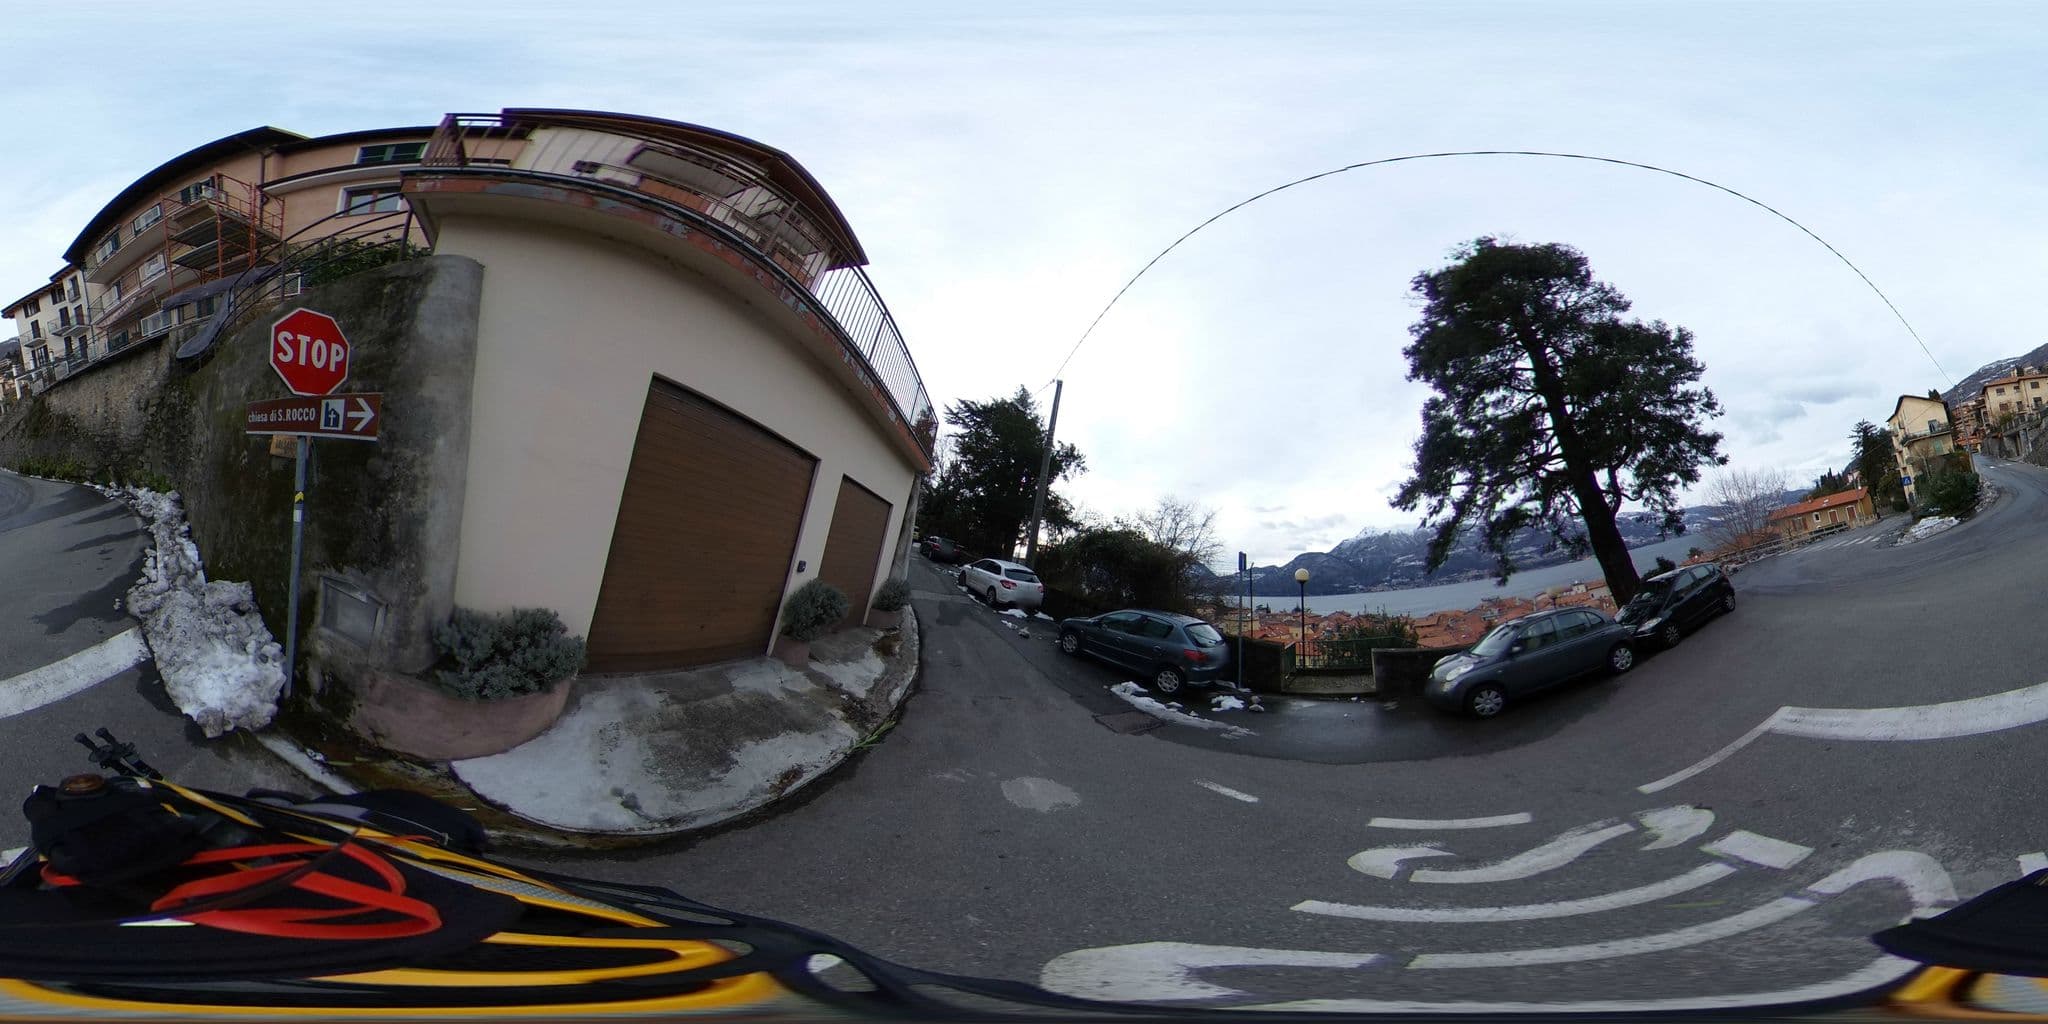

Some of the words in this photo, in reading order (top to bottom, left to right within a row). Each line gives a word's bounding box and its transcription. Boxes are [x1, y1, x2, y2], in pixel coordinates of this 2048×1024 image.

[277, 331, 344, 372] STOP
[248, 410, 268, 423] chiesa
[269, 409, 277, 422] di
